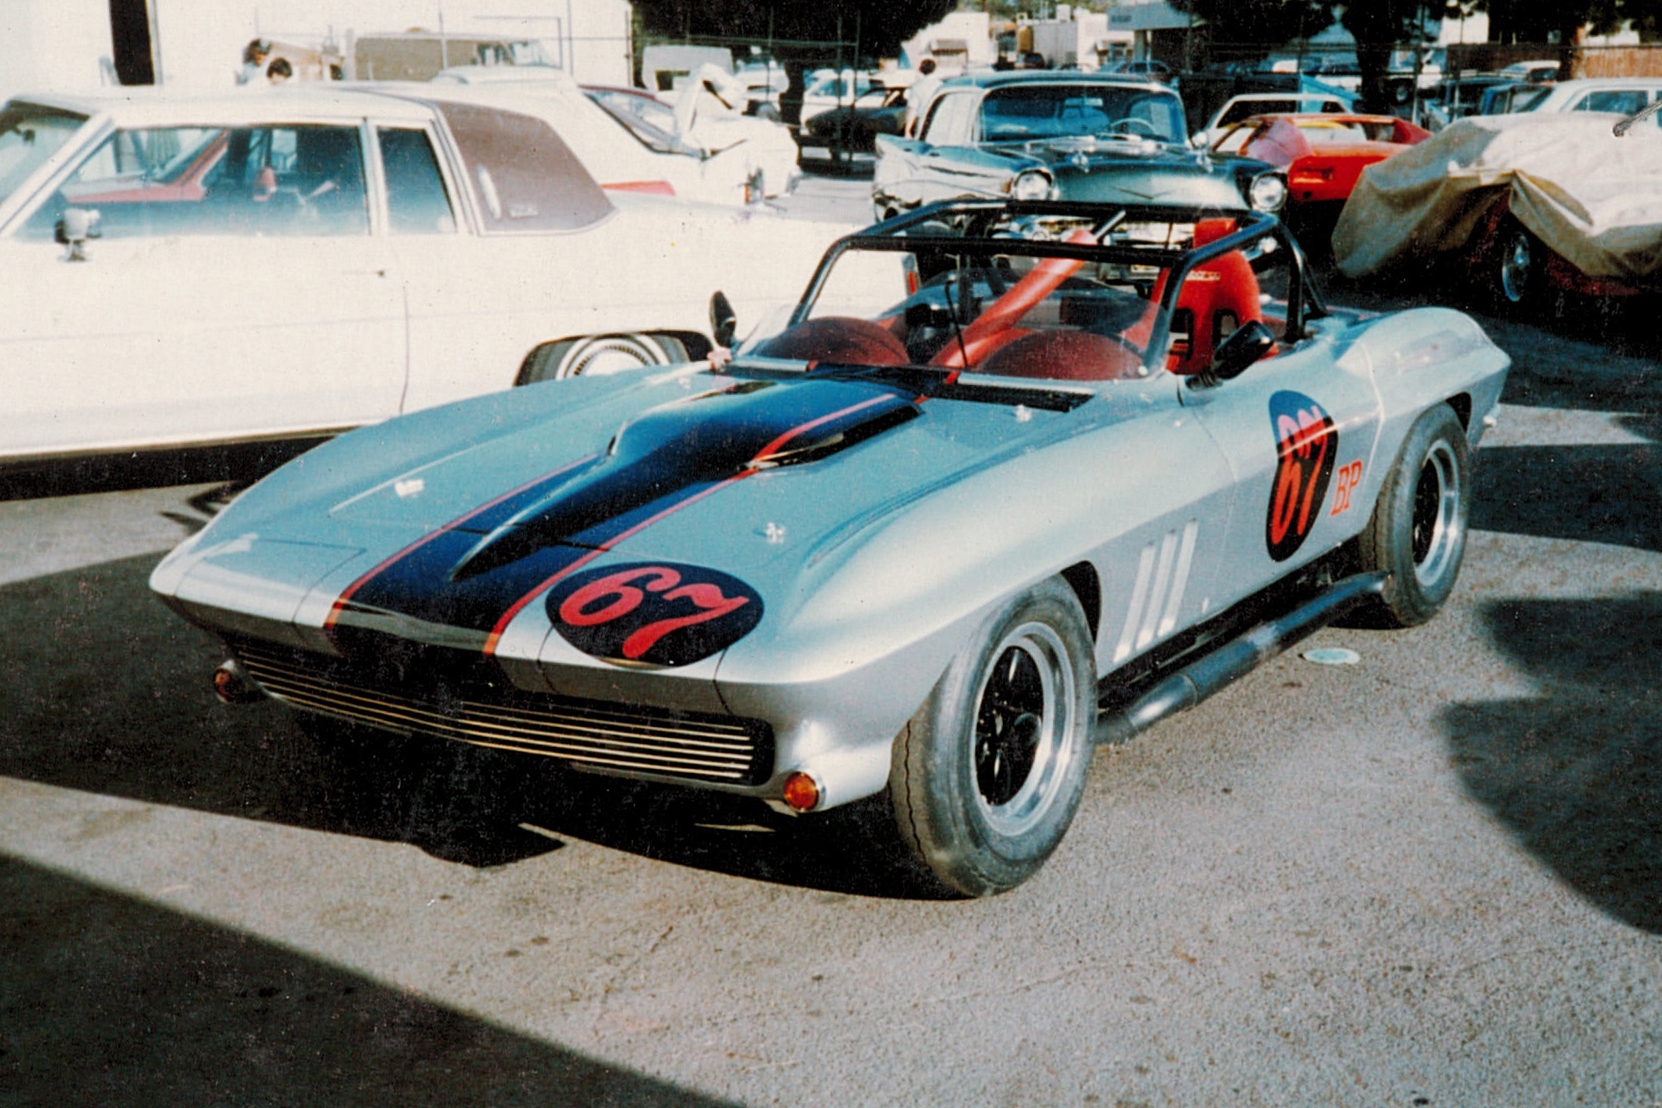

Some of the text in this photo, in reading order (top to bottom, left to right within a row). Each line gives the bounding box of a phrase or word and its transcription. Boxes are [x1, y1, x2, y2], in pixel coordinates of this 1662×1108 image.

[1271, 405, 1328, 545] 67
[1330, 460, 1363, 517] BP
[559, 566, 750, 659] 67
